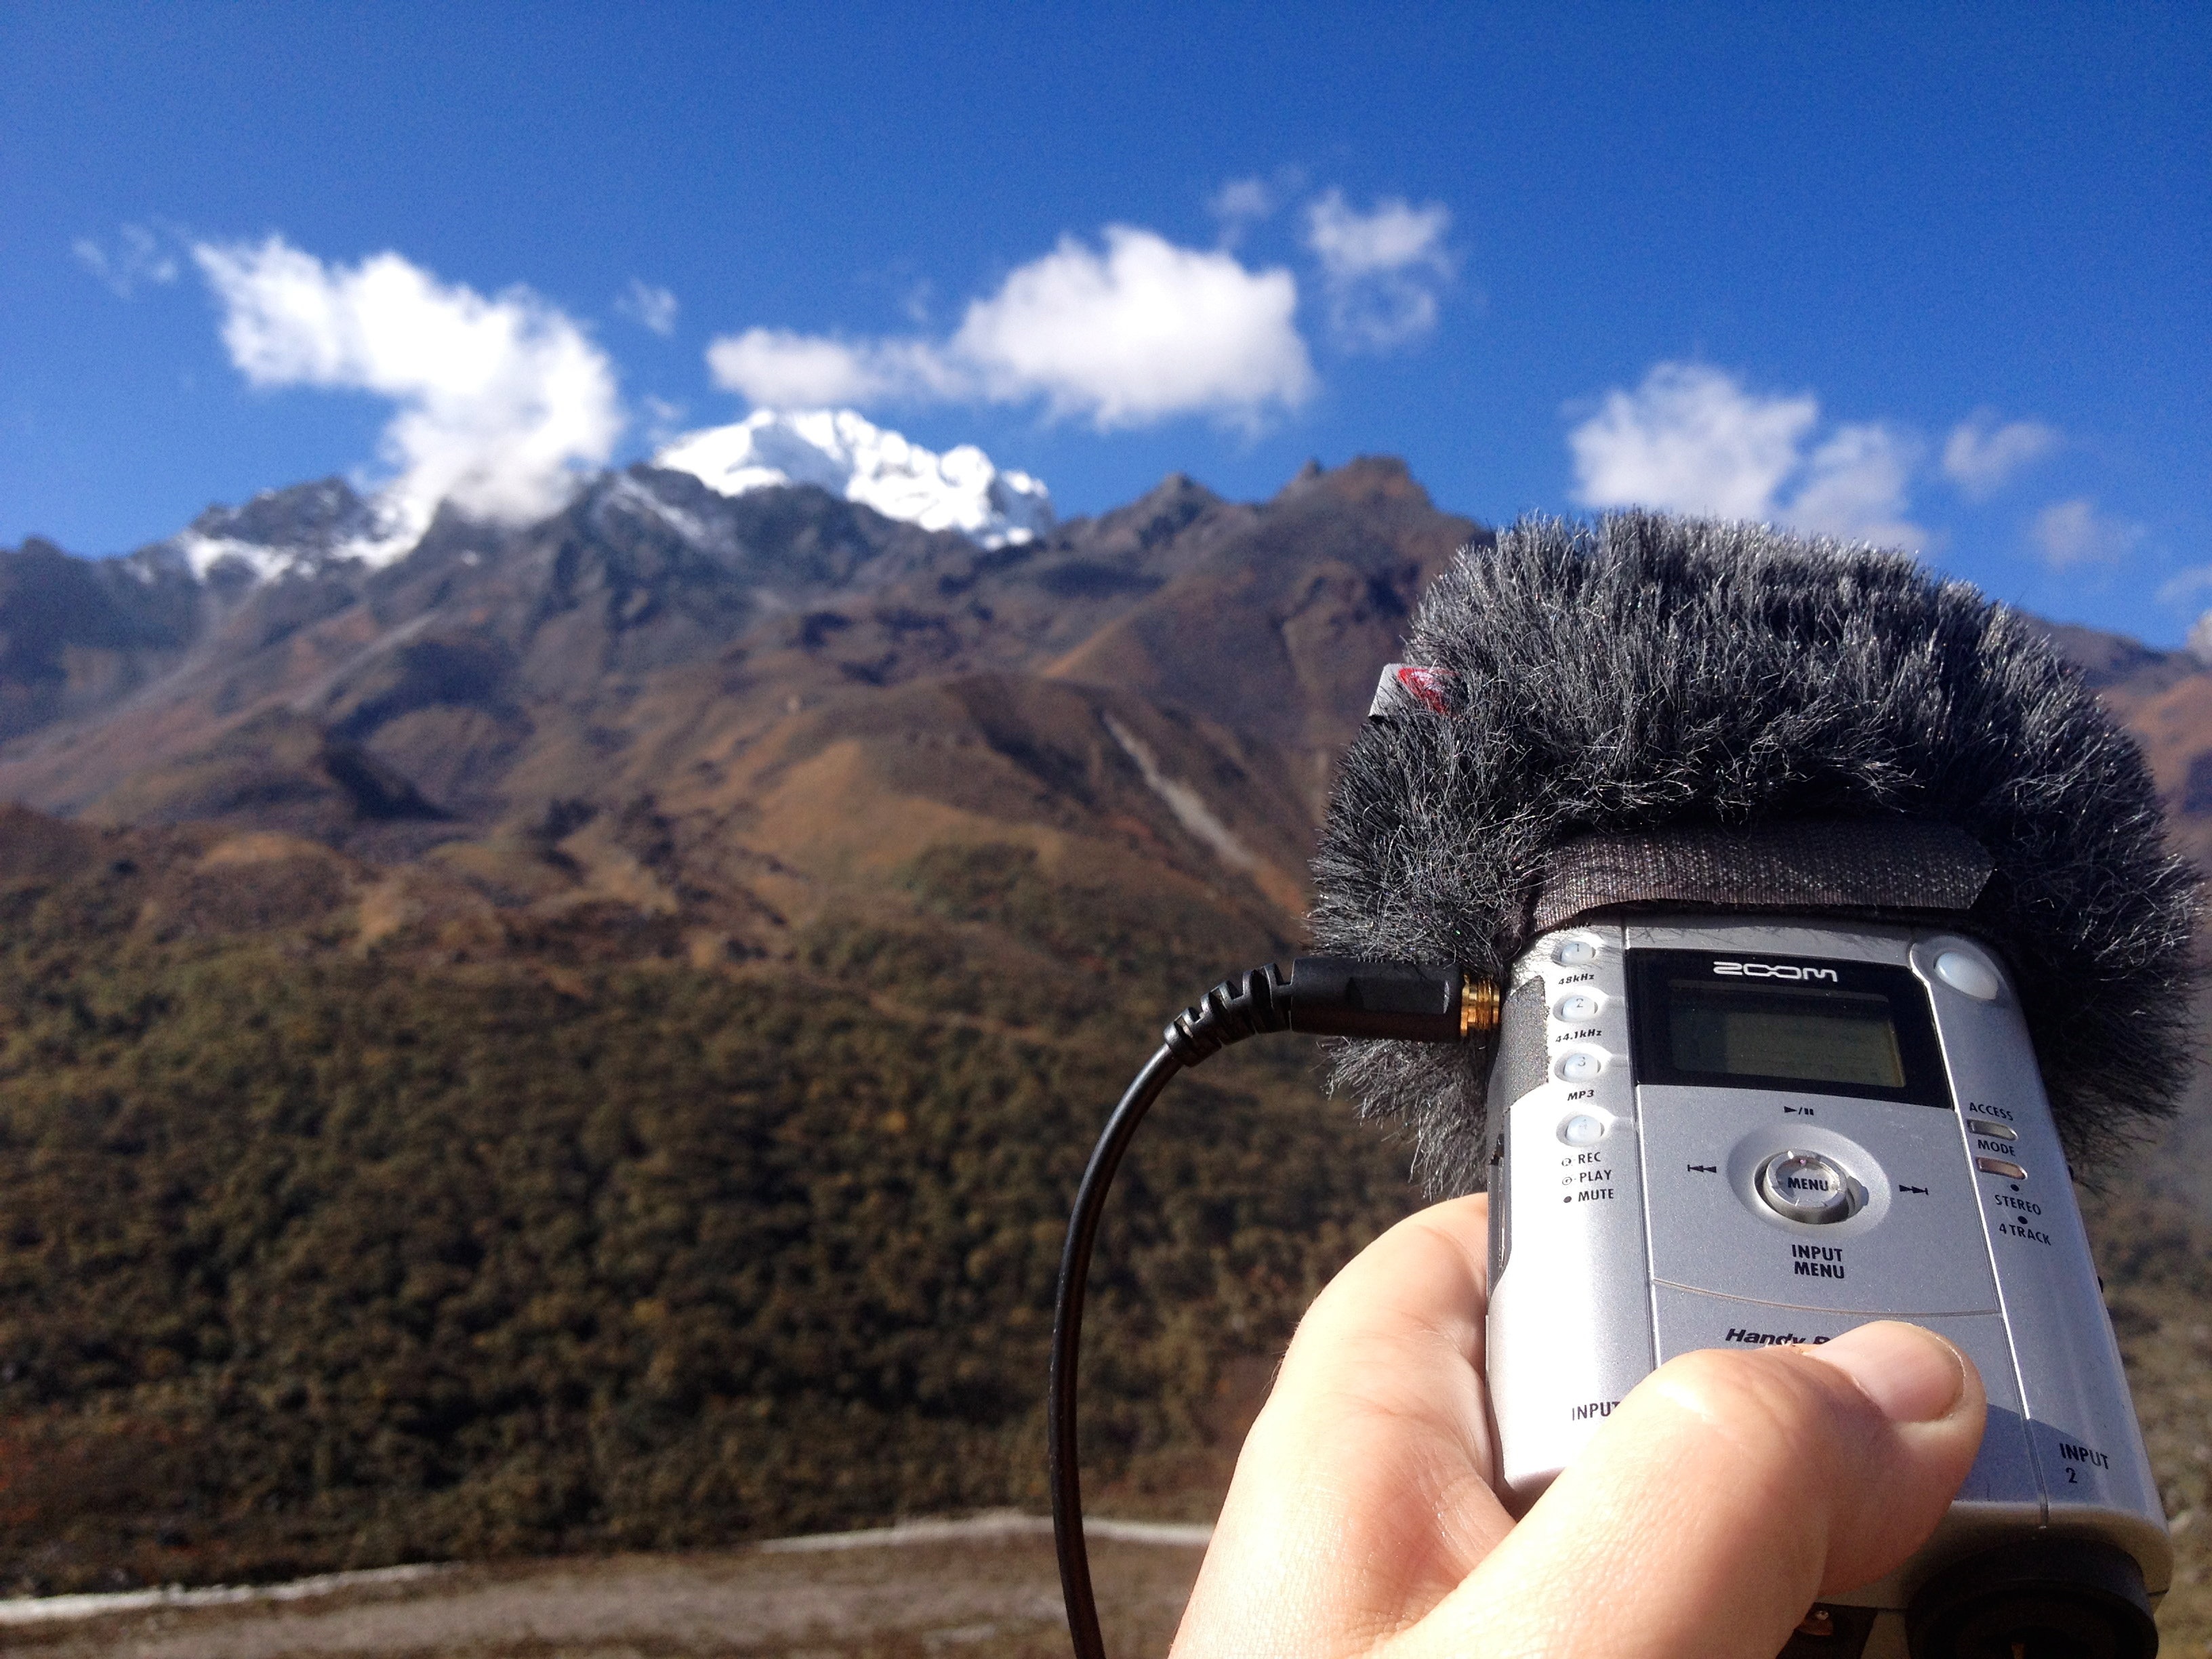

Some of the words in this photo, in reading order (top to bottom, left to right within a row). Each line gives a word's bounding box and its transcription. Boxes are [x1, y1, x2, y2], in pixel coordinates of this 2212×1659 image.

[1558, 972, 1595, 985] 48kHz
[1713, 961, 1838, 983] ZOOM
[1576, 998, 1584, 1008] 2
[1555, 1029, 1602, 1043] 44.1kHz
[1568, 1090, 1595, 1101] MP3
[1969, 1102, 2014, 1121] ACCESS
[1978, 1139, 2015, 1157] MODE
[1578, 1151, 1601, 1164] REC
[1579, 1169, 1612, 1183] PLAY
[1787, 1177, 1829, 1192] MENU
[1578, 1189, 1614, 1202] MUTE
[1994, 1194, 2042, 1216] STEREO
[1999, 1223, 2007, 1235] 4
[2009, 1224, 2051, 1246] TRACK
[1791, 1244, 1843, 1262] INPUT
[1794, 1261, 1845, 1279] MENU
[2060, 1443, 2110, 1470] INPUT
[2066, 1467, 2078, 1484] 2
